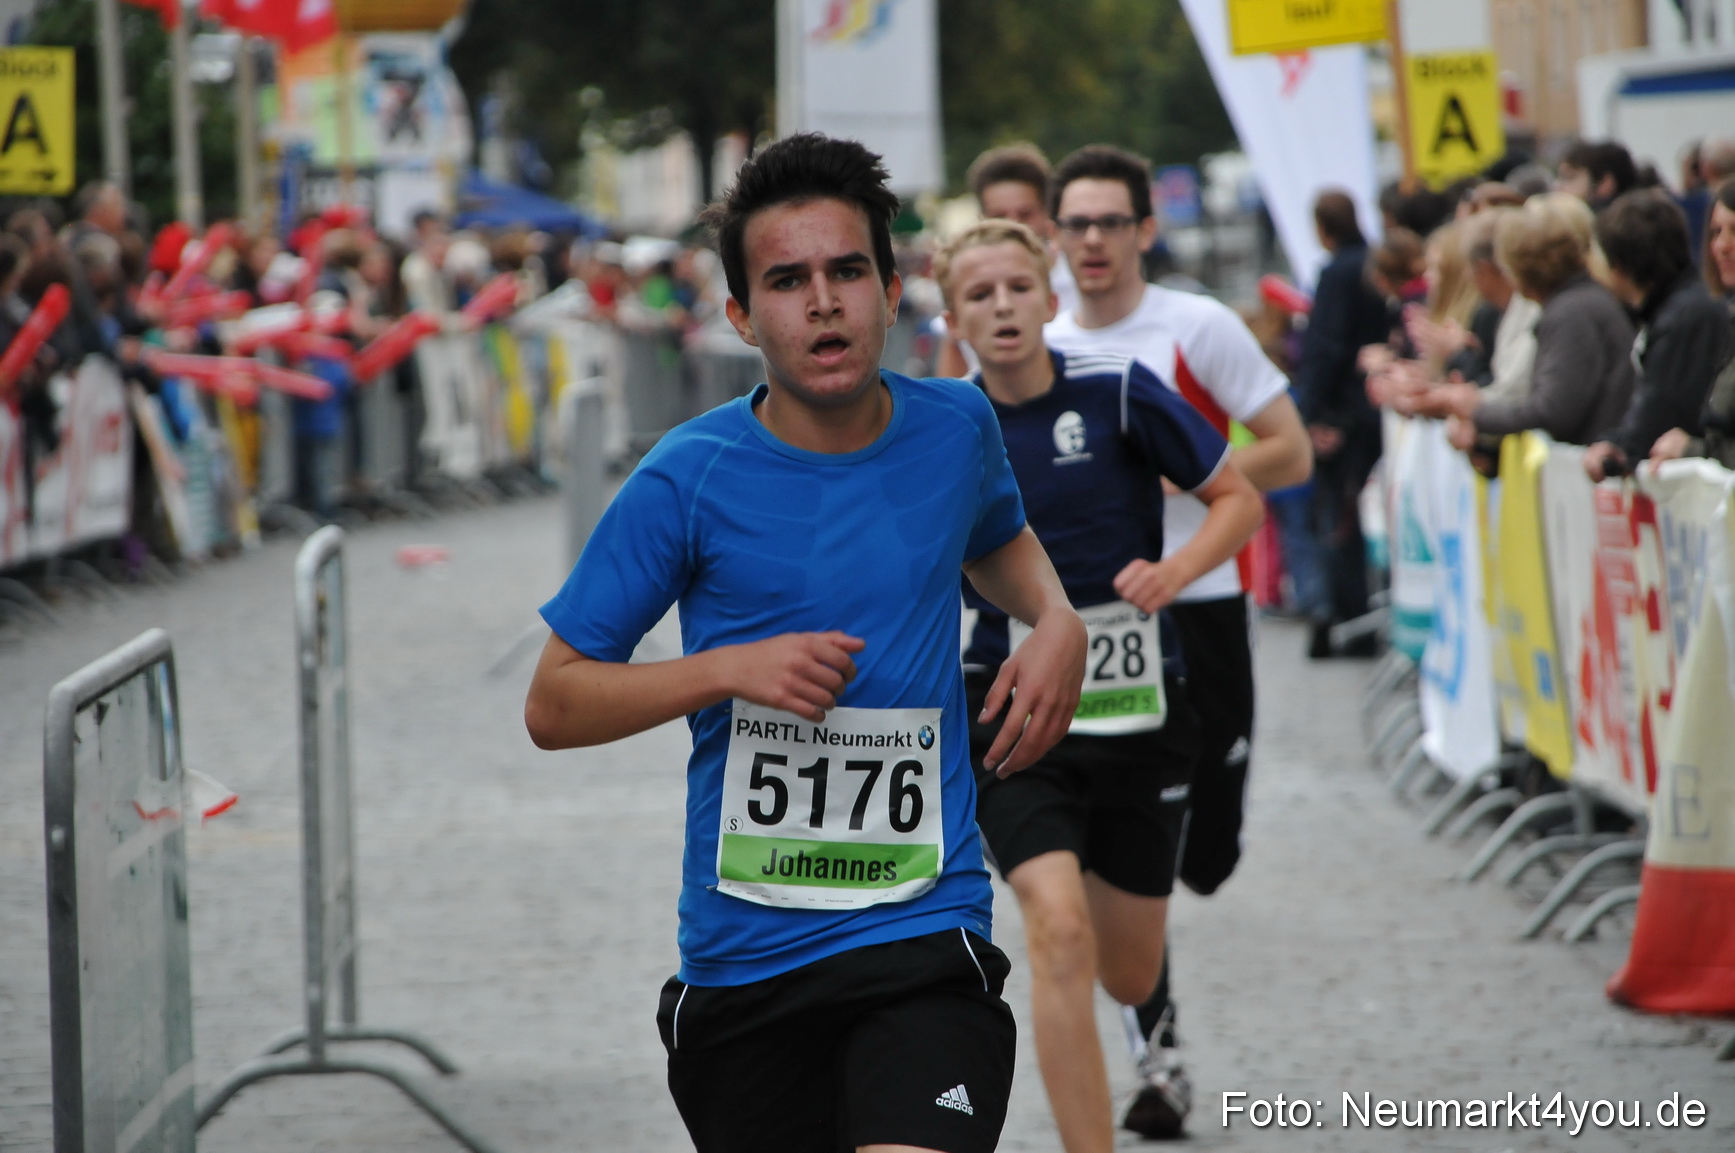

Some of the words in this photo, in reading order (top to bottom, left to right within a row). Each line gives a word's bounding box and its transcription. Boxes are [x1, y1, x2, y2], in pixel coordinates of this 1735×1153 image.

[1414, 56, 1487, 78] Block
[1, 92, 49, 155] A
[1431, 91, 1480, 153] A
[1091, 631, 1146, 680] 28
[1076, 694, 1152, 717] omas
[736, 718, 806, 743] PARTL
[812, 726, 913, 748] Neumarkt
[747, 751, 925, 834] 5176
[729, 818, 738, 832] S
[761, 847, 898, 883] Johannes
[935, 1097, 974, 1116] adidas
